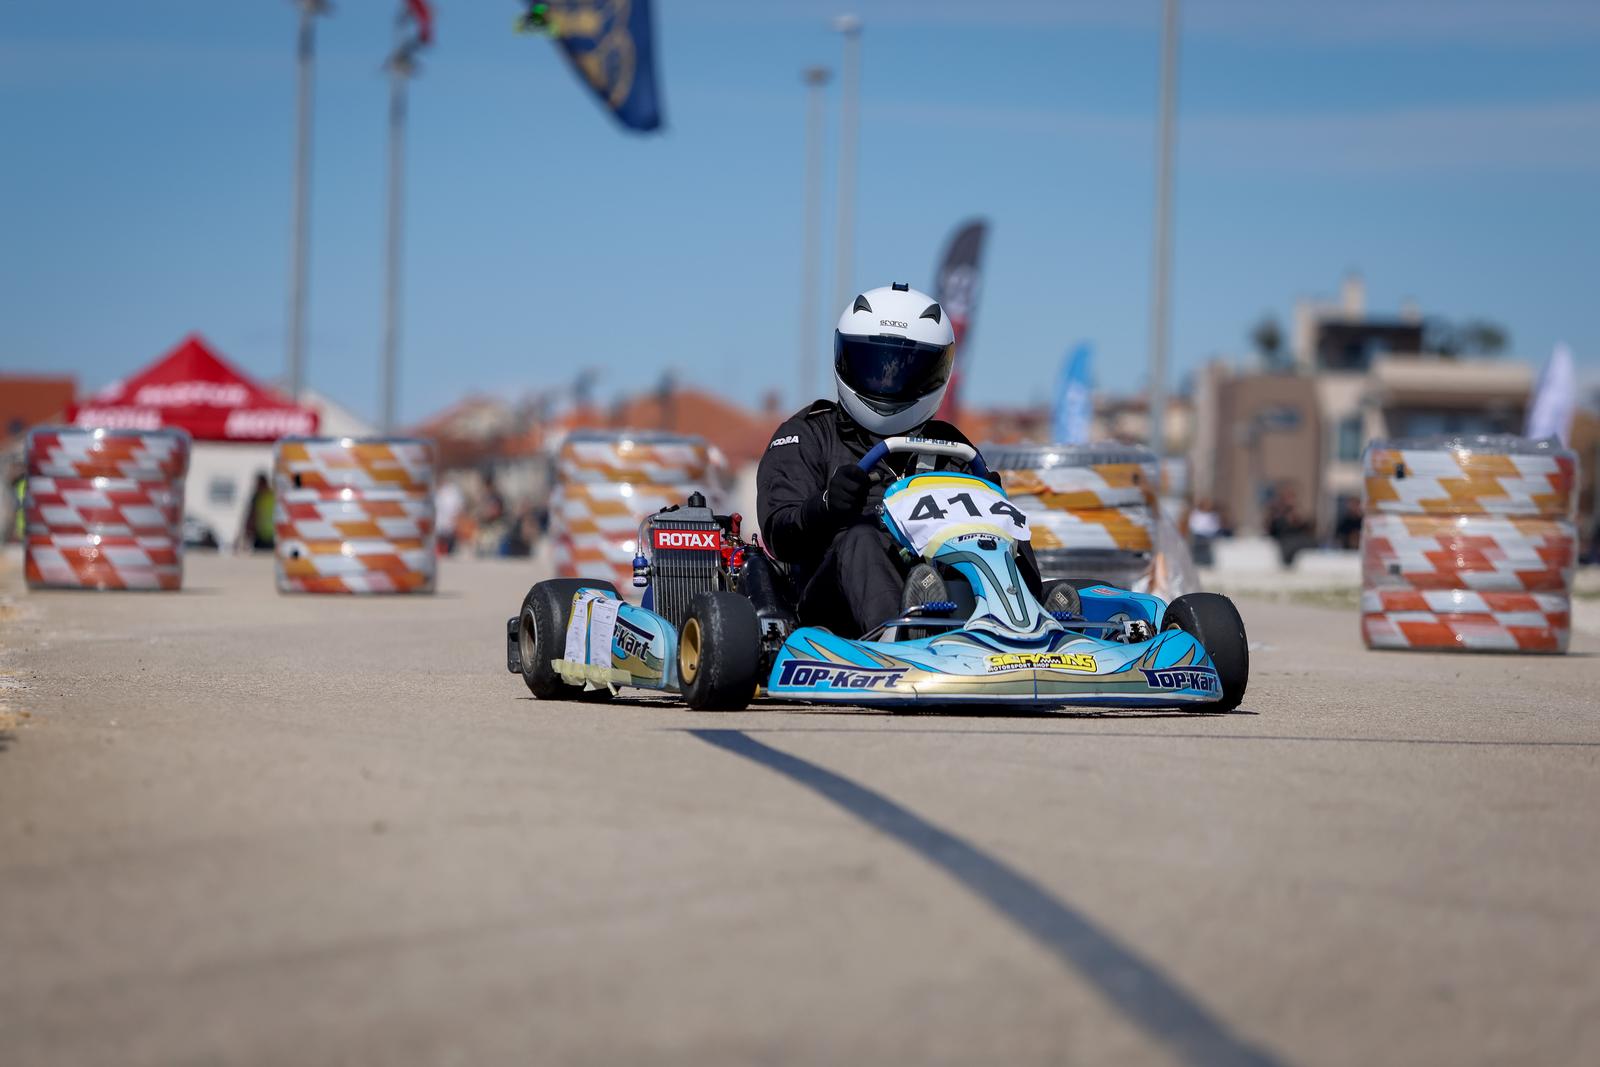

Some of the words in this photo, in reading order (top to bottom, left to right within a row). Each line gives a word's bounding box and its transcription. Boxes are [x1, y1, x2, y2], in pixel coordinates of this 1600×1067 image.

[908, 493, 1027, 529] 414
[659, 532, 715, 548] ROTAX
[778, 660, 910, 689] TOP-Kart
[987, 663, 1031, 673] MOTORSPORT
